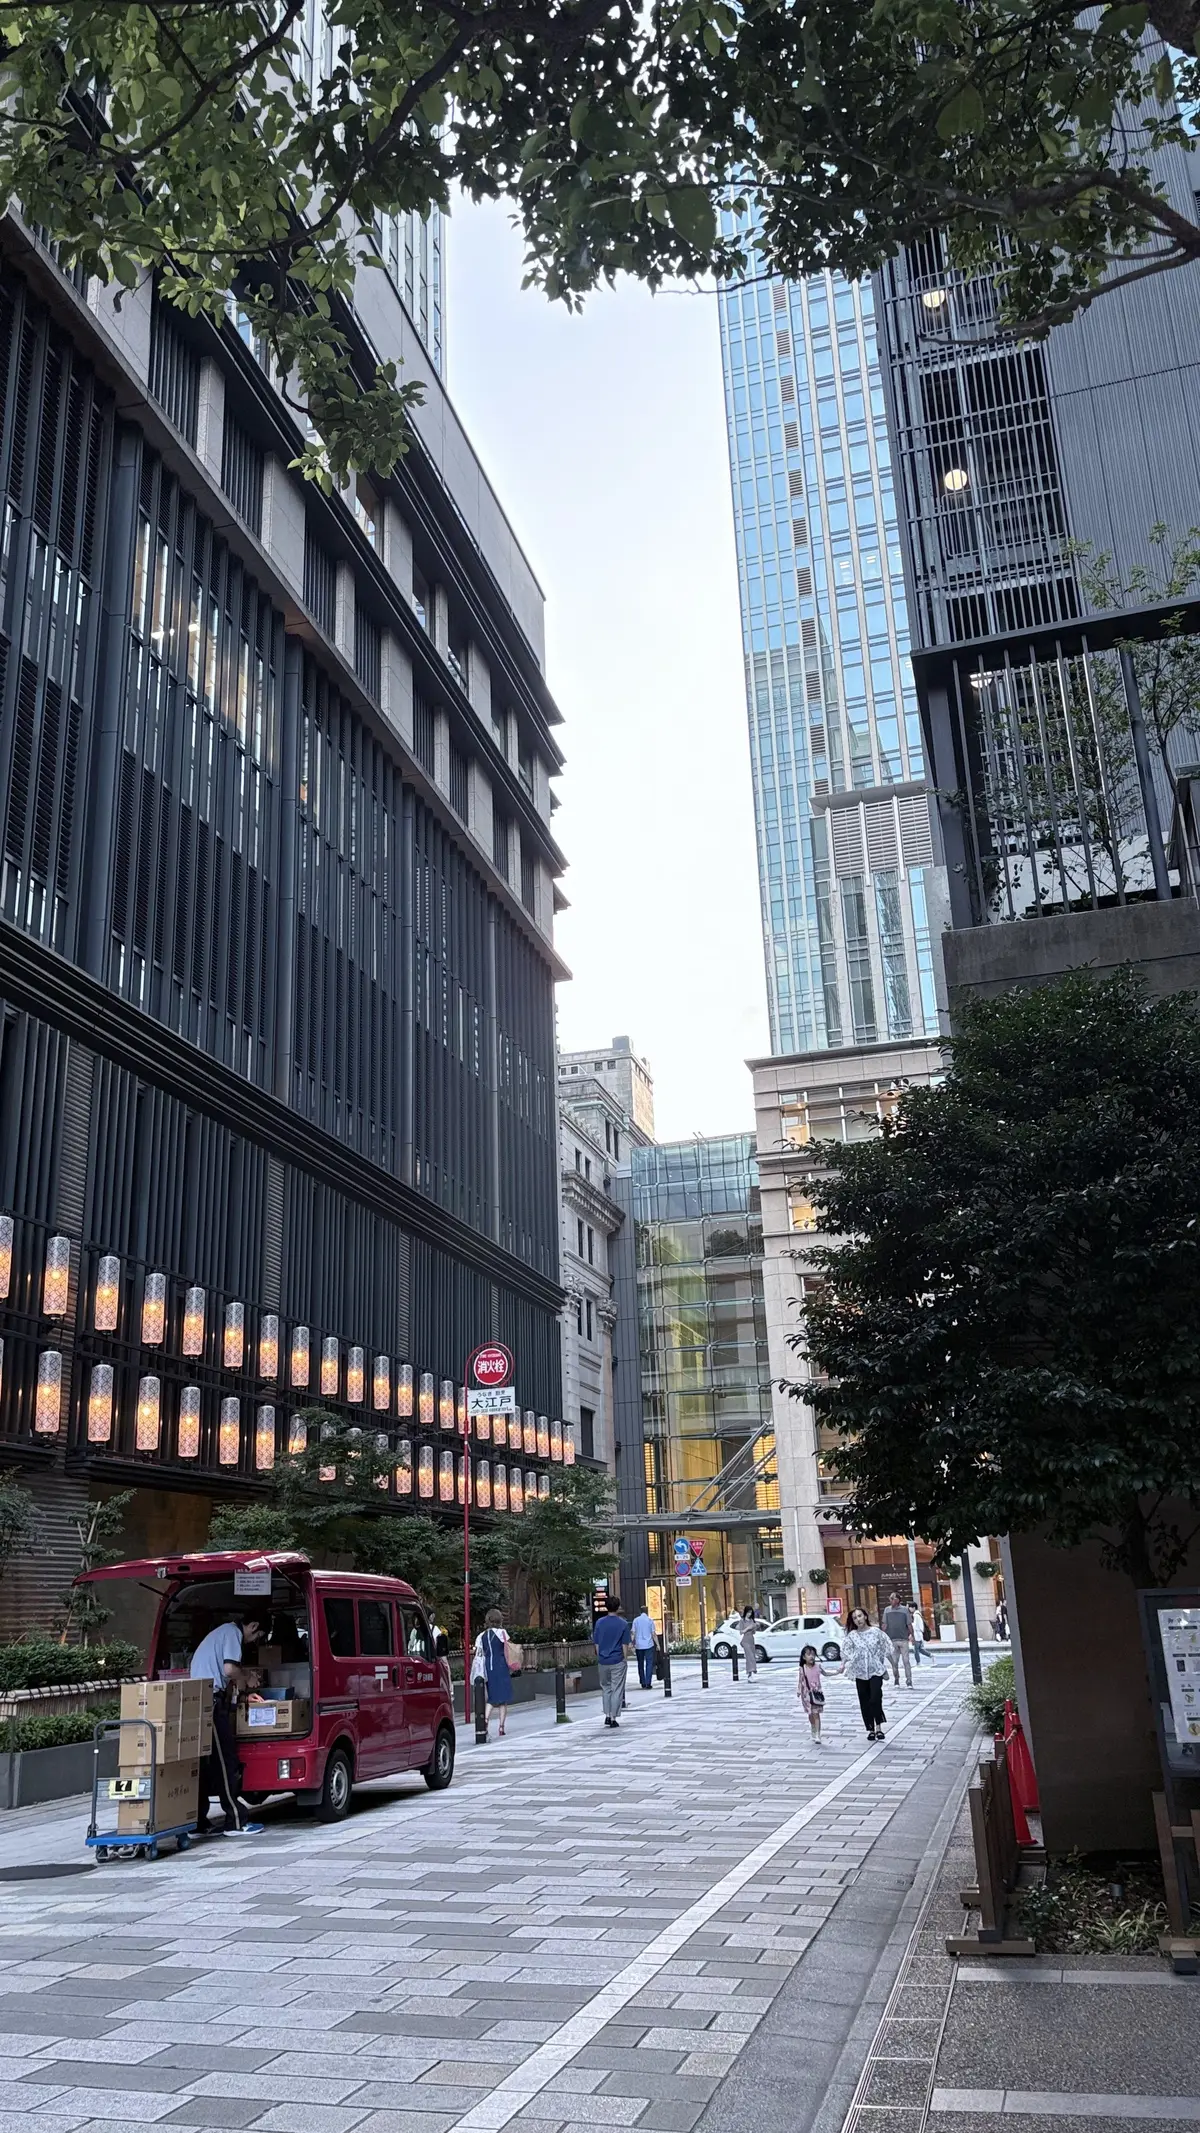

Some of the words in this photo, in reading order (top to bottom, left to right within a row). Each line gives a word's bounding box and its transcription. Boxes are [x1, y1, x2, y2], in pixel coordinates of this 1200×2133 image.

[477, 1359, 504, 1374] 消火栓
[471, 1395, 512, 1409] 大江戸
[119, 1780, 128, 1792] 7
